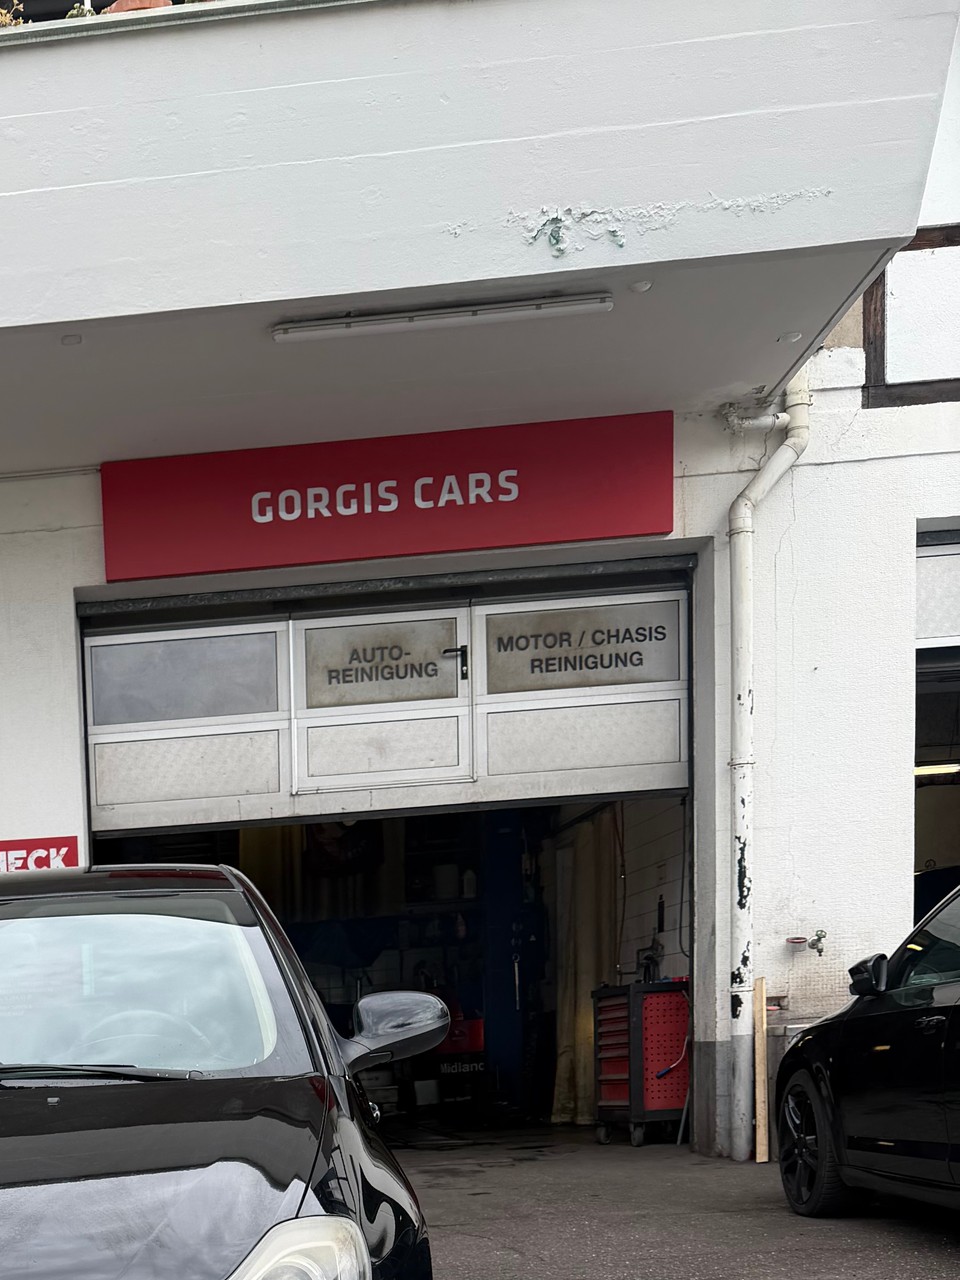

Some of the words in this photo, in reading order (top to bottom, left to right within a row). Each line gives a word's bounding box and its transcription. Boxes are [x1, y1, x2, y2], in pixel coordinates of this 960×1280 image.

[251, 480, 399, 524] GORGIS
[414, 469, 519, 509] CARS
[497, 632, 572, 653] MOTOR
[591, 625, 667, 646] CHASIS
[349, 645, 411, 665] AUTO-
[531, 651, 644, 674] REINIGUNG
[327, 662, 439, 685] REINIGUNG
